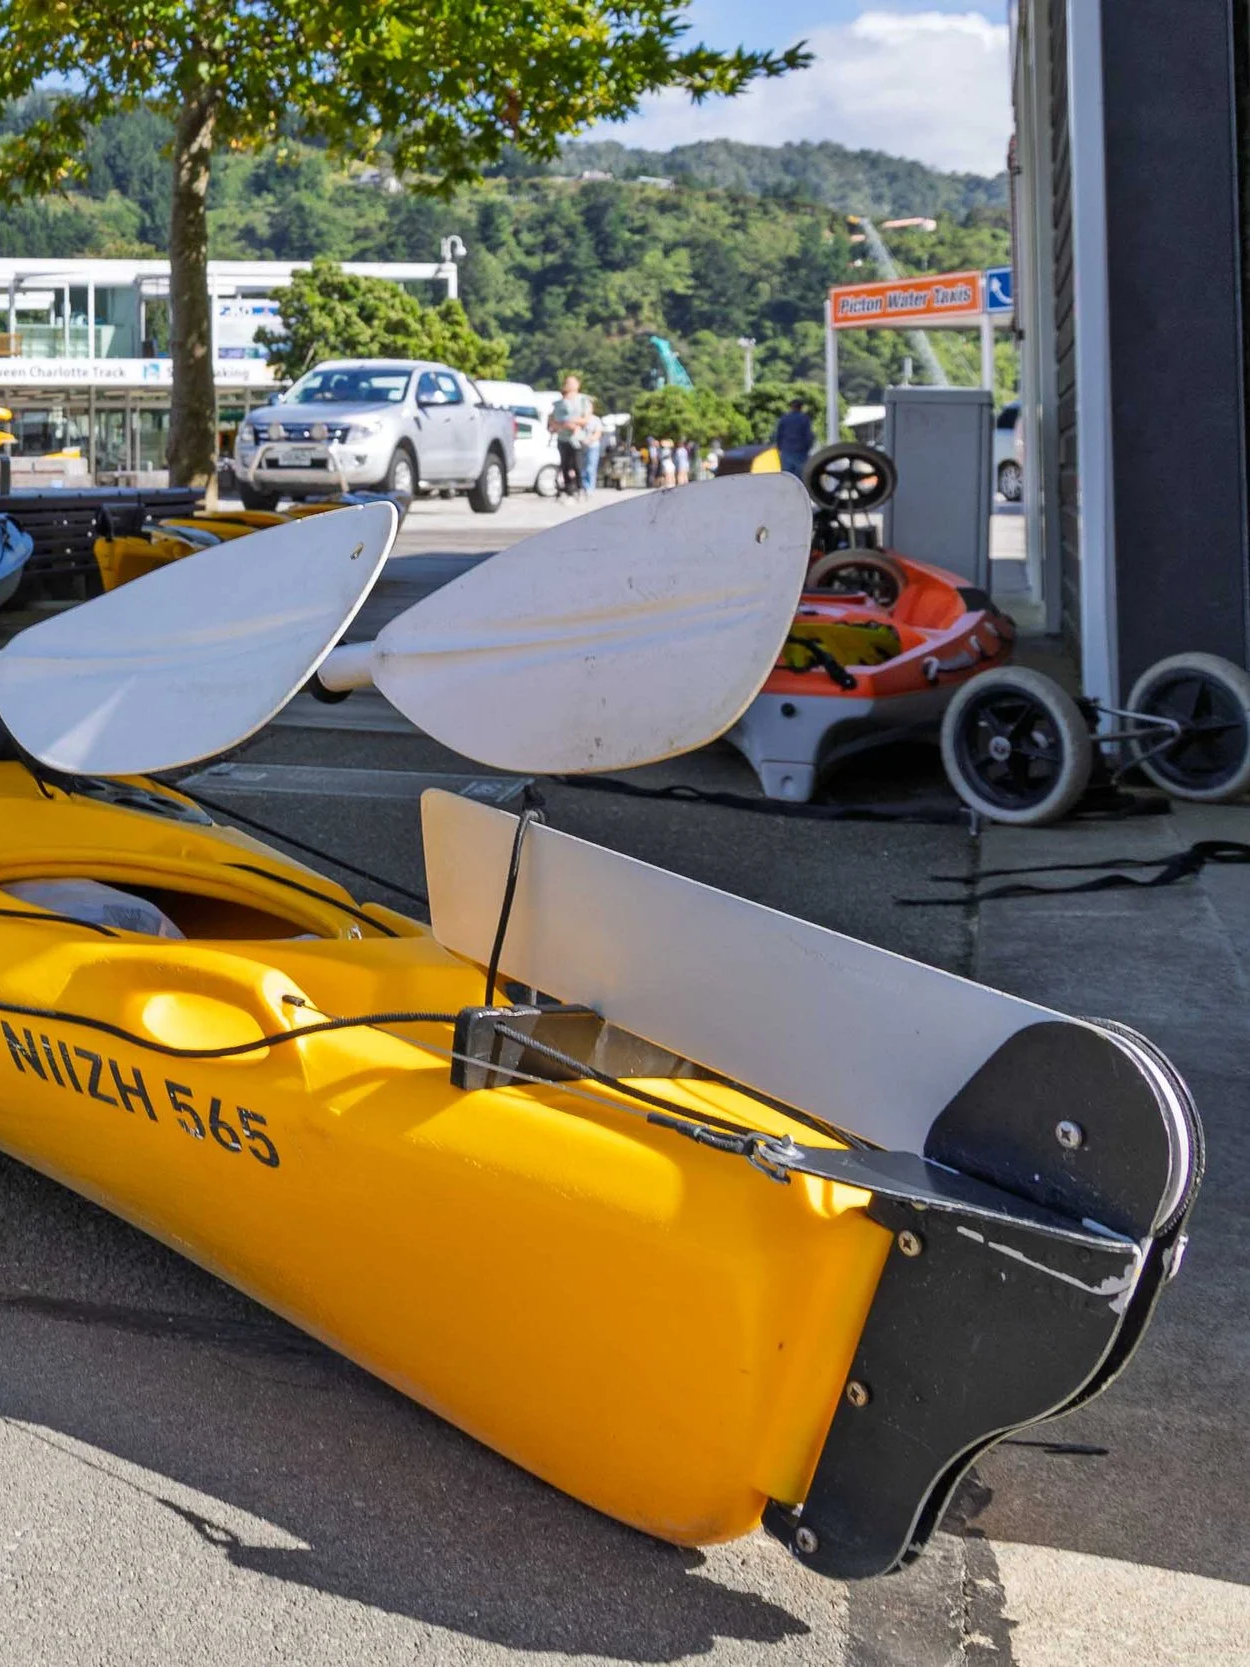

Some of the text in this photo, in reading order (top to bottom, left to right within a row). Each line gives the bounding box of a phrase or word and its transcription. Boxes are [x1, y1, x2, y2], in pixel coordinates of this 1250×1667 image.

[838, 284, 971, 315] Picton Water Taxis
[30, 365, 87, 378] Charlotte
[93, 366, 126, 378] Track
[214, 367, 250, 381] aking
[0, 1020, 159, 1122] NIIZH
[164, 1078, 280, 1169] 565
